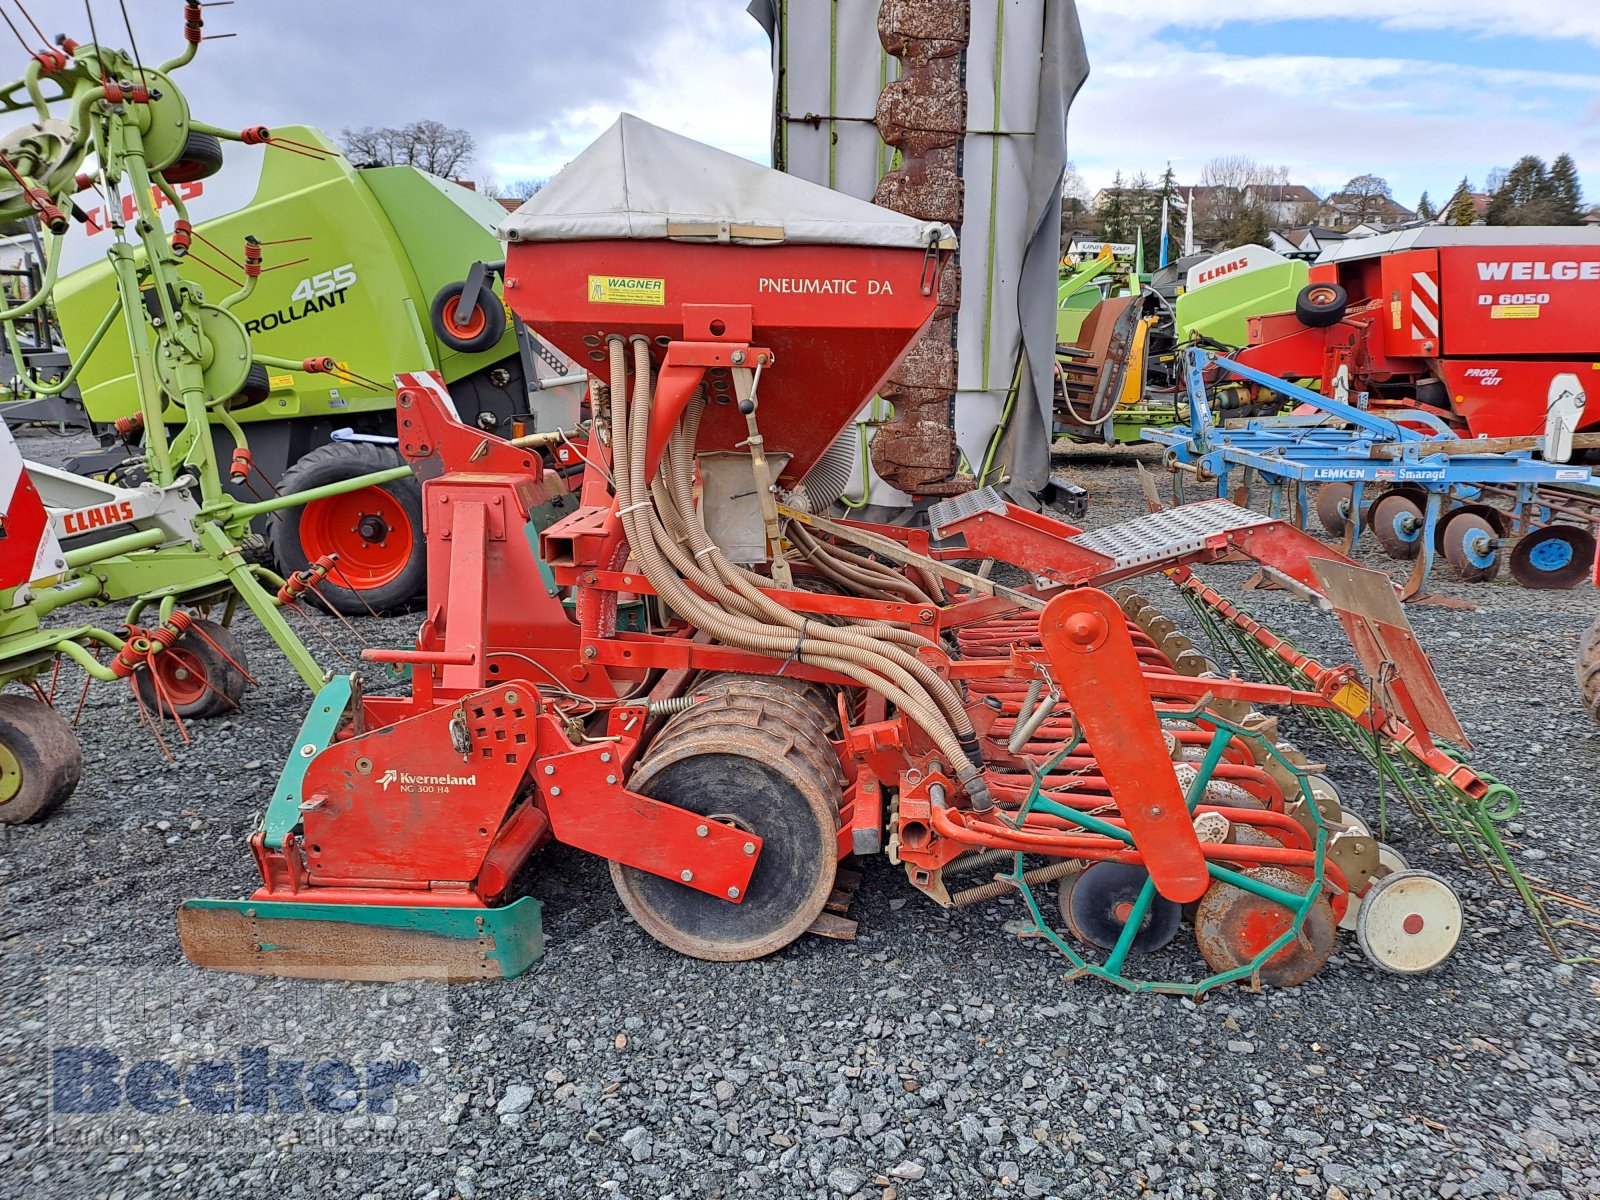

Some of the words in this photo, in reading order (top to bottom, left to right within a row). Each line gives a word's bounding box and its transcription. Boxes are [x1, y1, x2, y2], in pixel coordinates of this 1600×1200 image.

[1082, 243, 1131, 252] UNIRAP
[1199, 257, 1248, 284] CLAAS
[1476, 261, 1600, 281] WELGE
[291, 263, 357, 302] 455
[608, 278, 662, 290] WAGNER
[759, 278, 857, 294] PNEUMATIC
[867, 279, 893, 295] DA
[1478, 294, 1493, 305] D
[1498, 293, 1550, 305] 6050
[244, 287, 348, 337] ROLLANT
[1464, 368, 1498, 377] PROFI
[1480, 377, 1503, 386] CUT
[1314, 469, 1366, 479] LEMKEN
[1399, 468, 1447, 480] Smaragd
[63, 501, 134, 534] CLAAS
[400, 772, 477, 785] Kverneland
[417, 785, 434, 793] 300
[437, 786, 450, 794] H4
